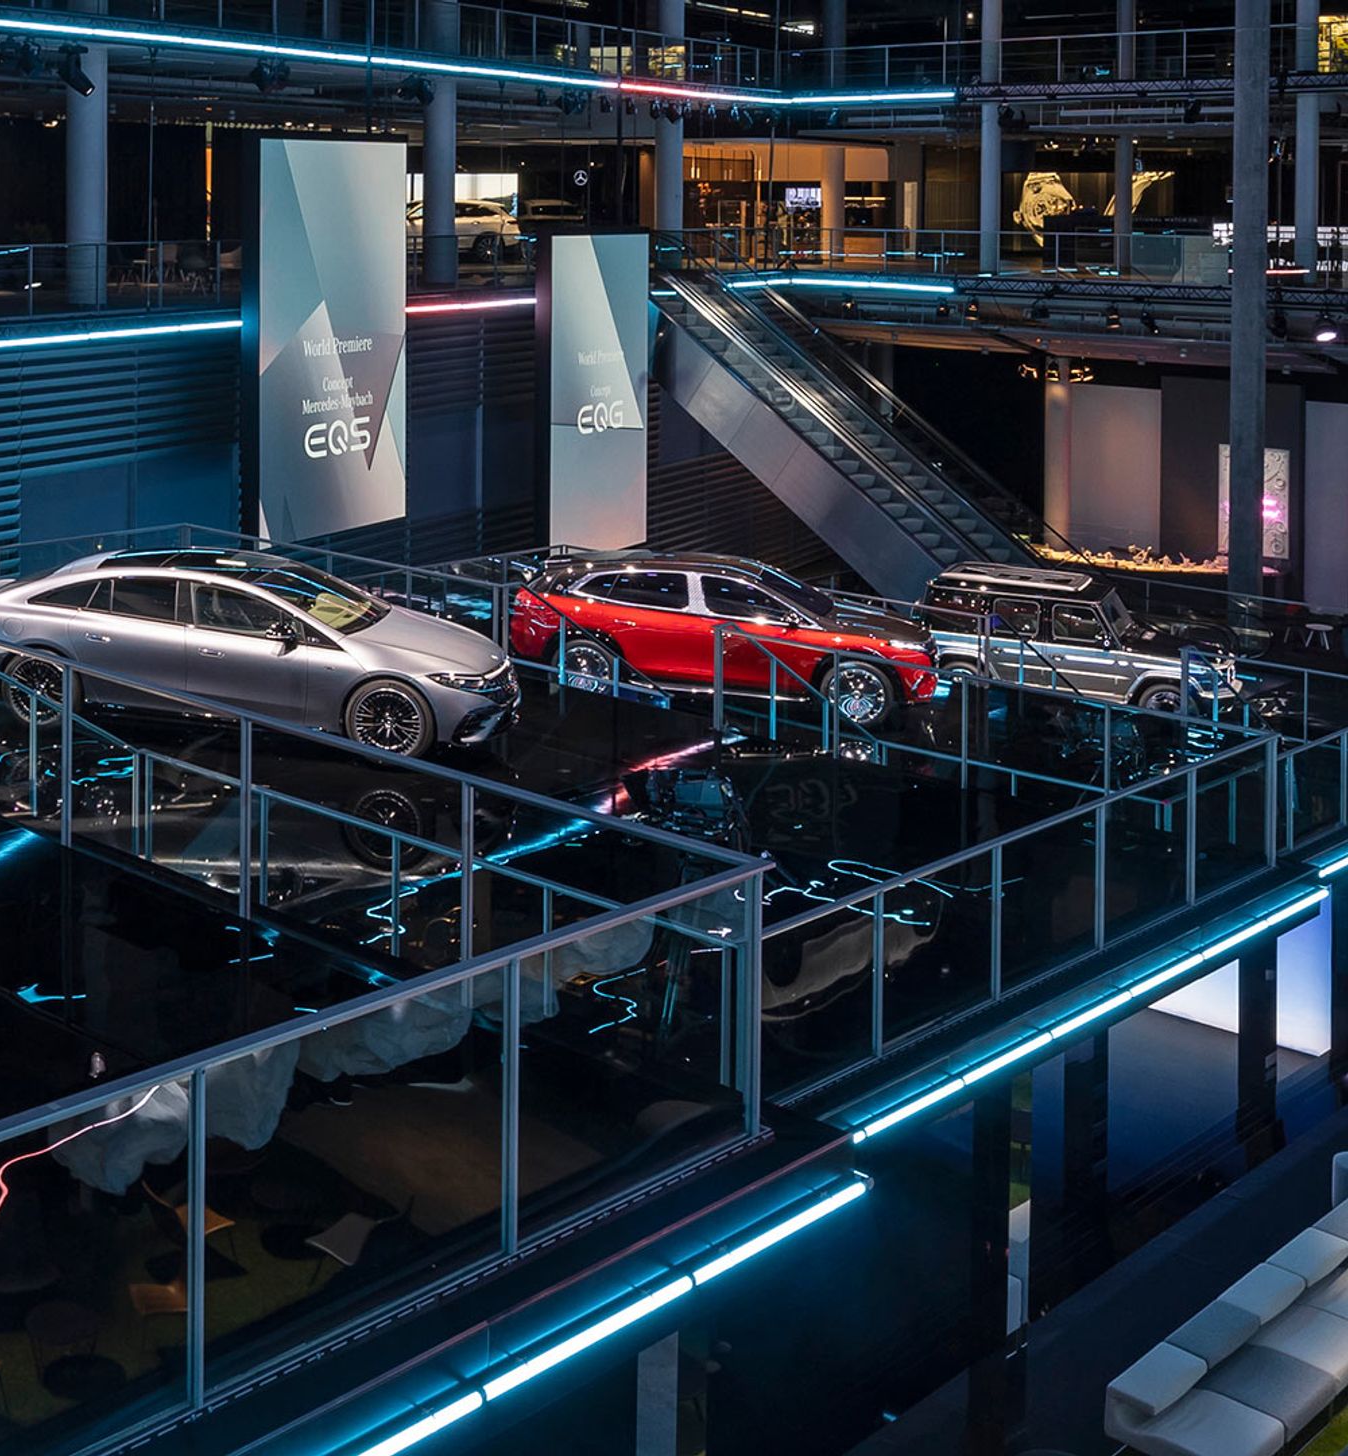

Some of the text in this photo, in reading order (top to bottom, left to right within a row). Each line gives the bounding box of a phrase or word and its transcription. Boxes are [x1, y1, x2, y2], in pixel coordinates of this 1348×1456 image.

[303, 336, 373, 357] World Premiere
[322, 376, 353, 393] Concept
[577, 401, 624, 434] EQG
[304, 416, 370, 459] EQS
